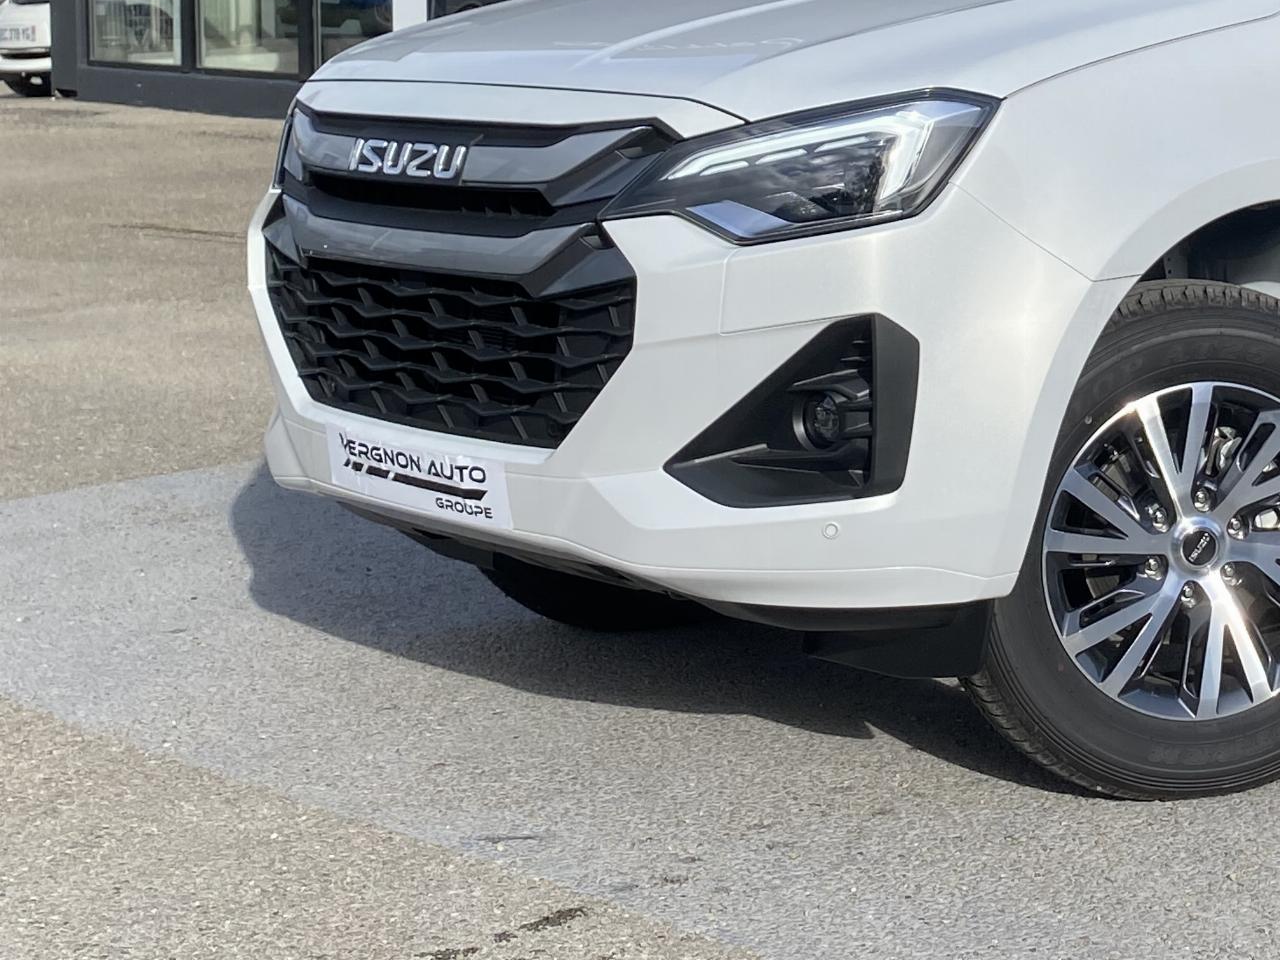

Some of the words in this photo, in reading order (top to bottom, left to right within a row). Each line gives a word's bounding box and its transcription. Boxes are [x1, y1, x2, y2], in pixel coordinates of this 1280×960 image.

[349, 138, 467, 179] ISUZU
[338, 432, 422, 474] VERGNON
[427, 460, 487, 484] AUTO
[435, 497, 494, 519] GROUPE
